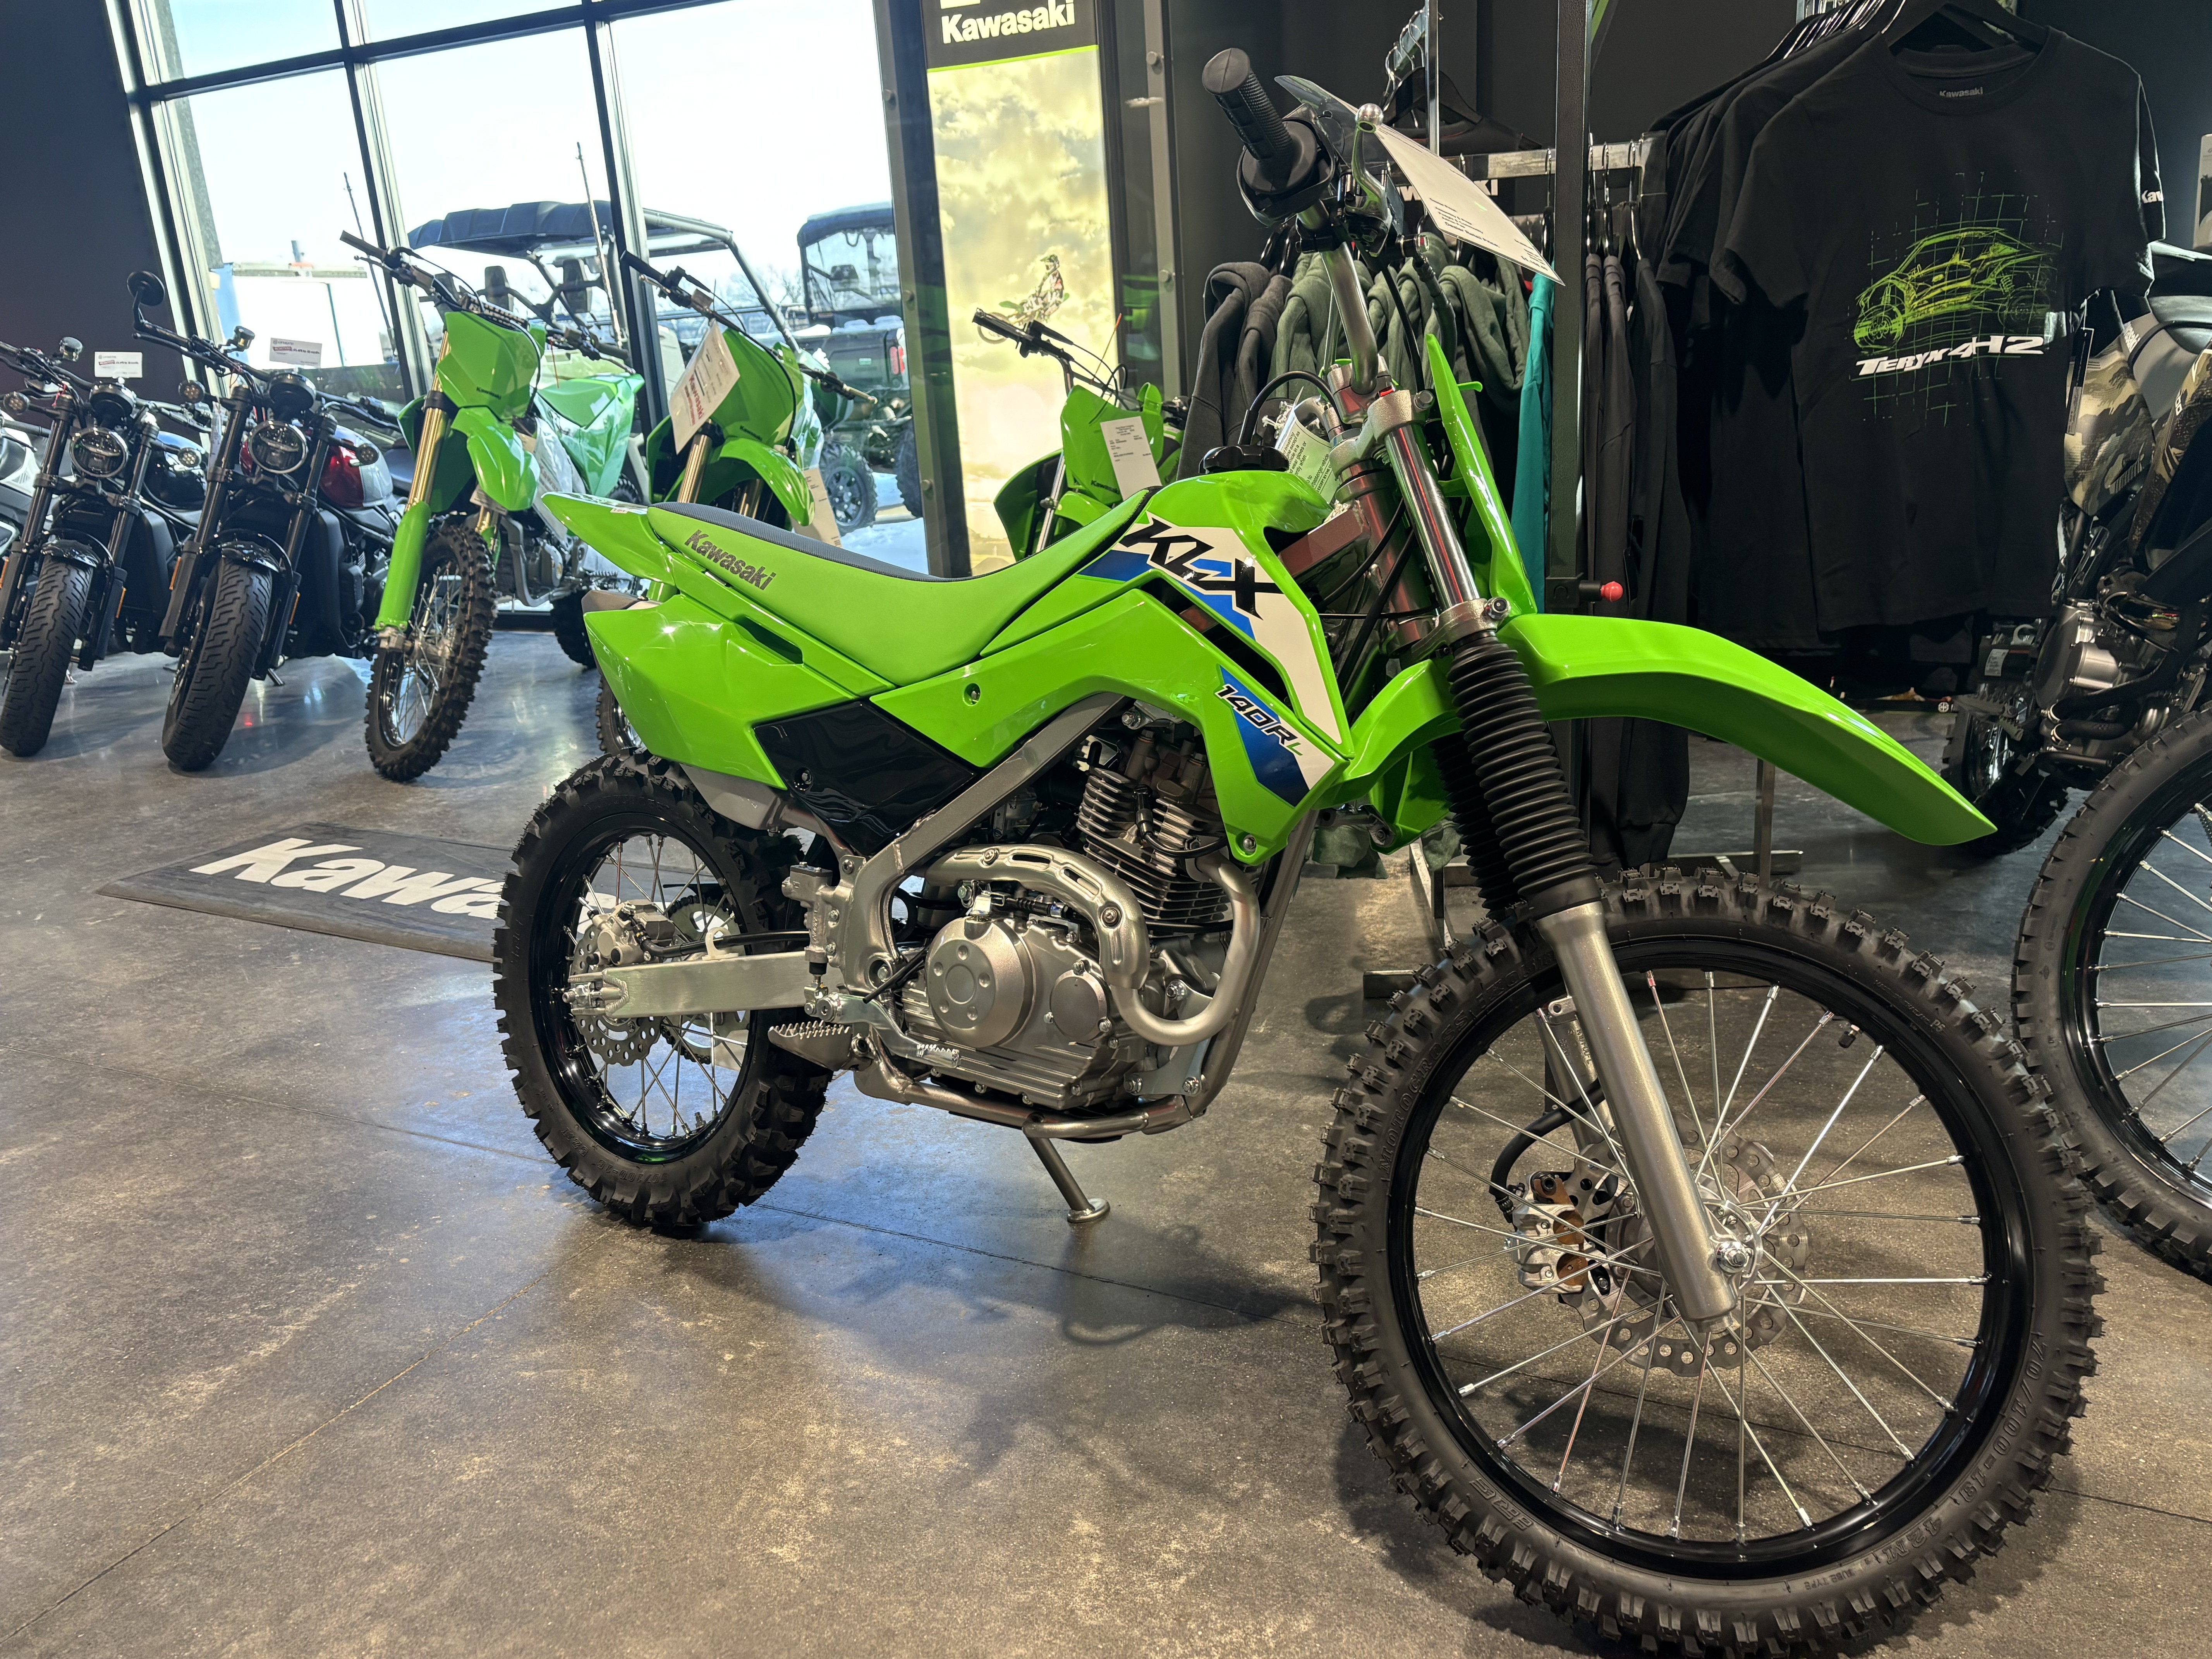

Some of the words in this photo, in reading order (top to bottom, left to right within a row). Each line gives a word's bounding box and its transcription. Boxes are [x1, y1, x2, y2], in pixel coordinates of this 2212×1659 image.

[941, 0, 1075, 44] Kawasaki
[1939, 86, 1984, 98] Kawasaki
[684, 529, 776, 591] Kawasaki
[1118, 518, 1285, 620] KLX
[189, 837, 510, 920] Kawa
[1379, 1010, 1470, 1172] MOTOCROSS
[1886, 1515, 1944, 1564] 42M
